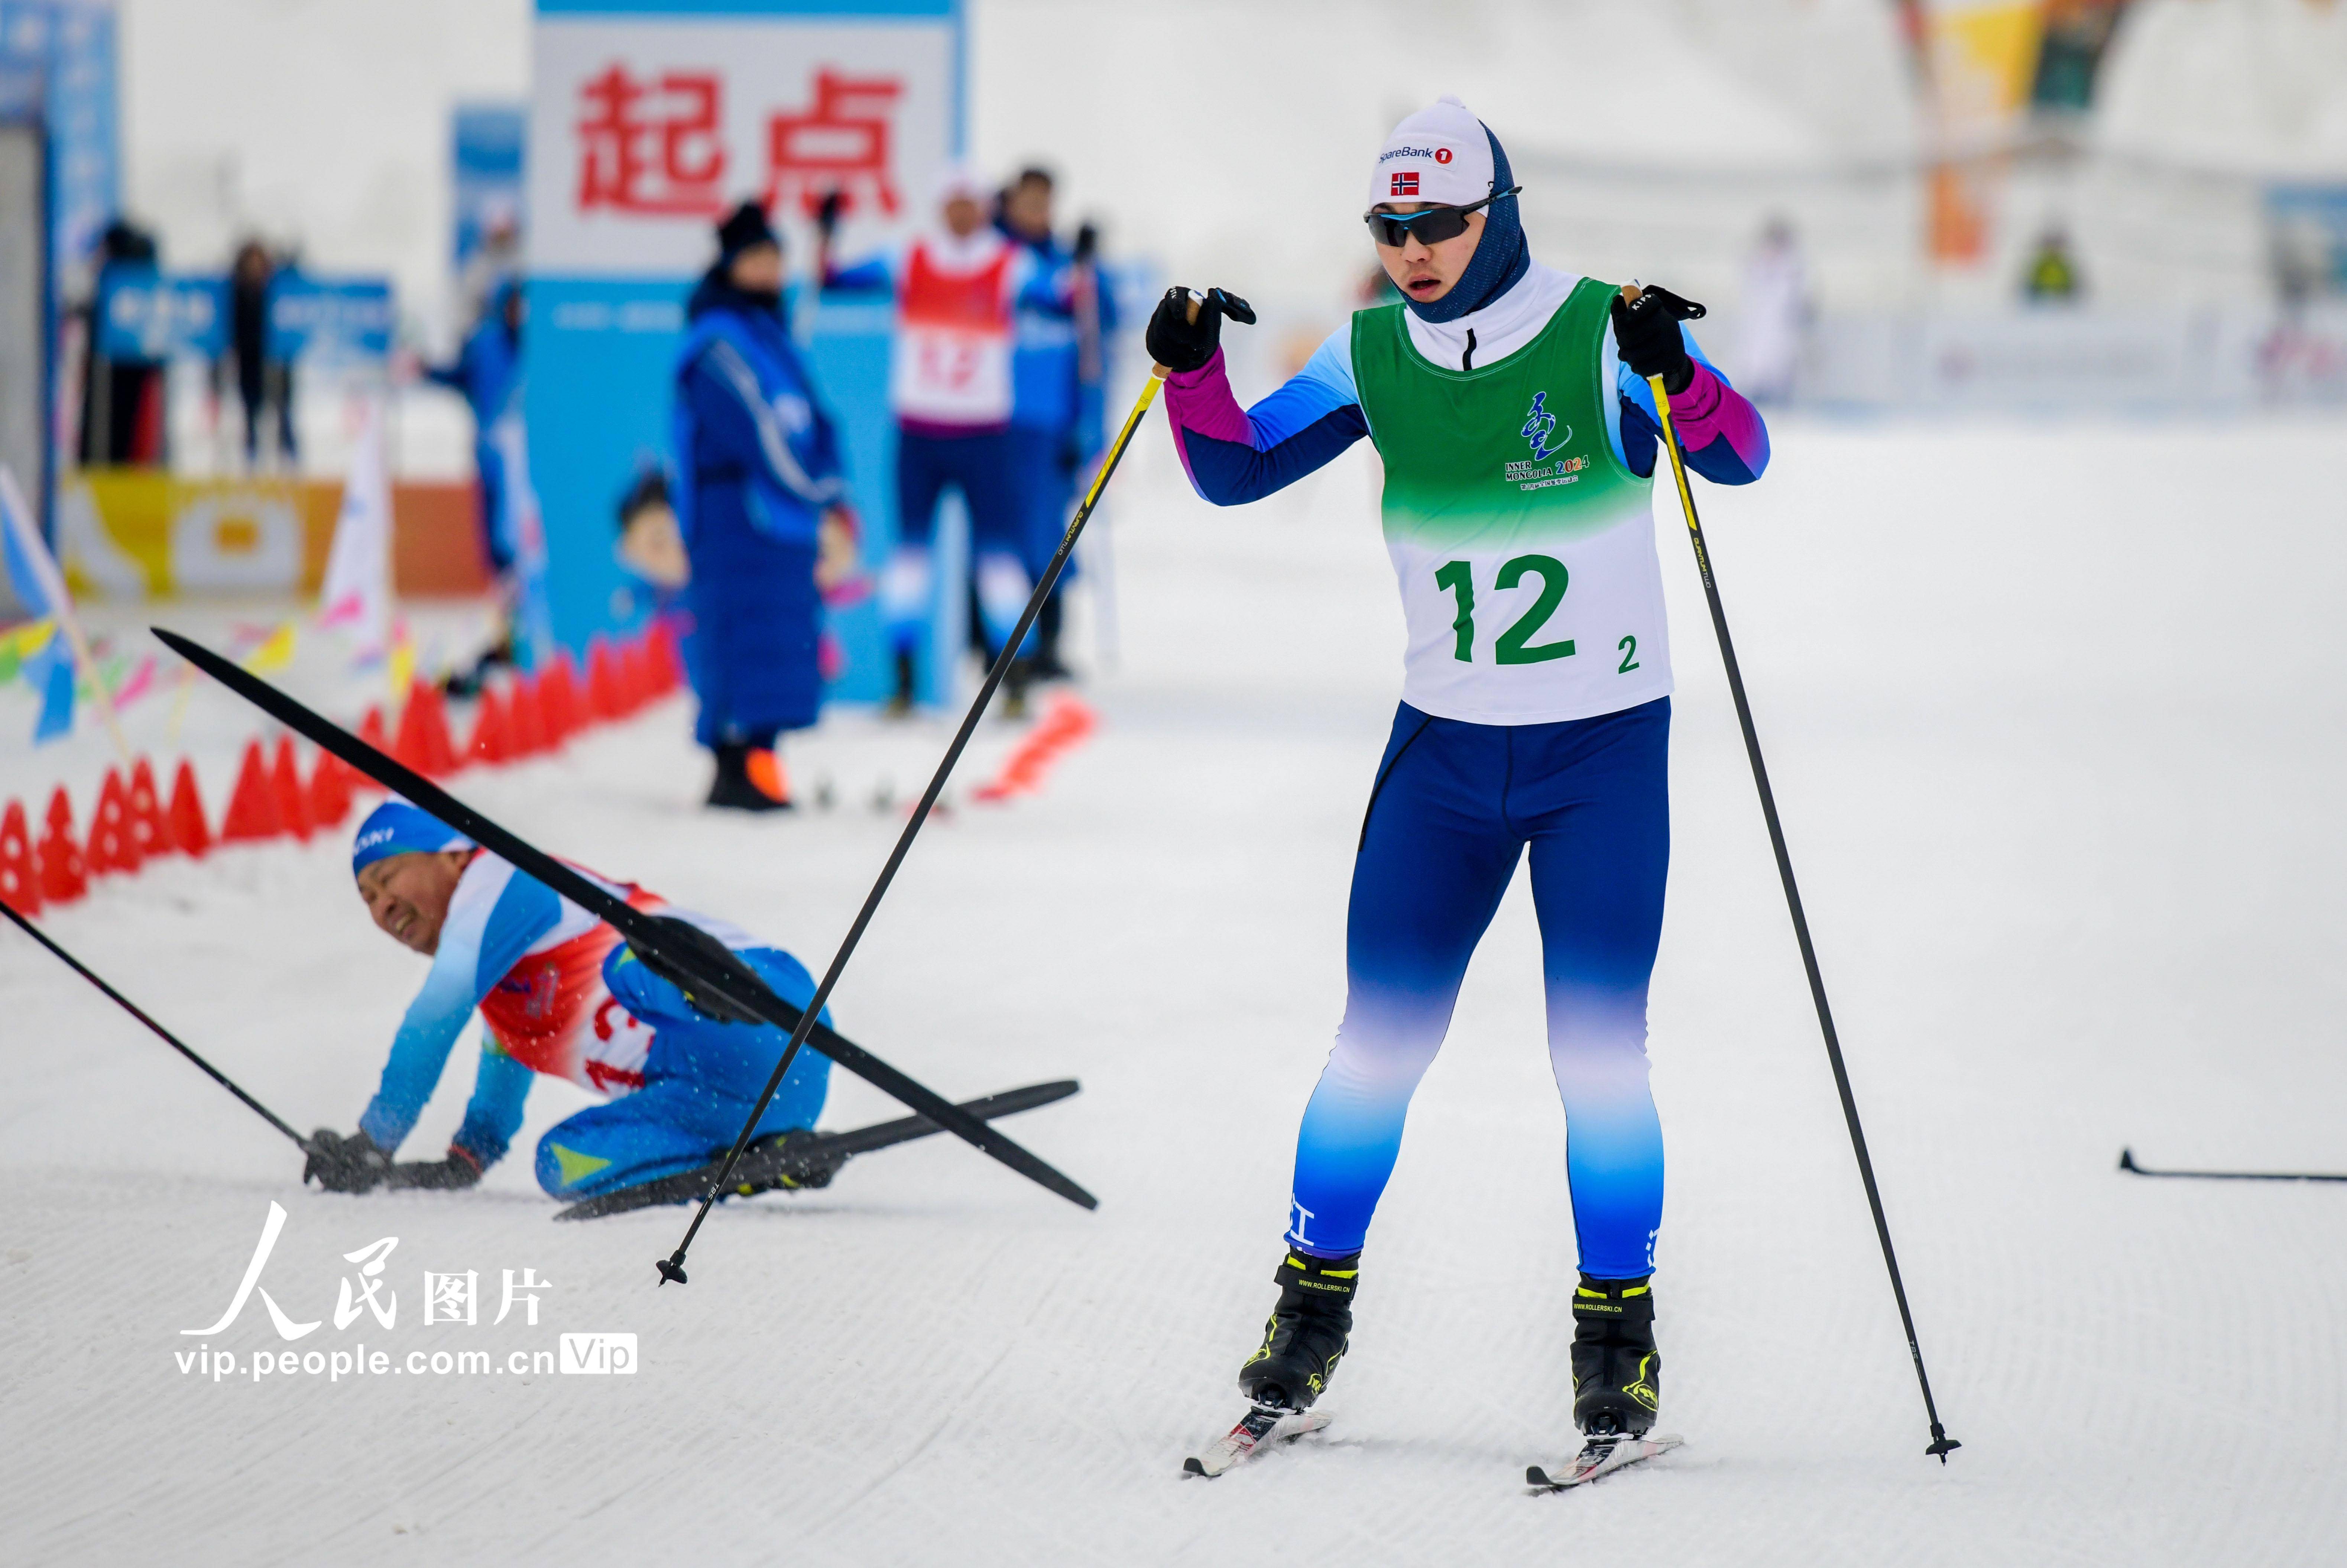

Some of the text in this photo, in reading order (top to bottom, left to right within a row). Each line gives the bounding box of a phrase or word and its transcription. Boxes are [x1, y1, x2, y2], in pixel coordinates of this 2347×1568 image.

[580, 63, 902, 224] 起点
[1378, 147, 1433, 163] SpareBank
[1505, 461, 1532, 472] INNER
[1506, 454, 1590, 482] MONGOLIA 2024
[1693, 537, 1707, 572] QUANTUM
[1435, 554, 1576, 665] 12
[1618, 635, 1640, 674] 2
[708, 1183, 720, 1200] TBS
[1299, 1279, 1350, 1293] WWW.ROLLERSKI.CN
[1573, 1303, 1623, 1313] WWW.ROLLERSKI.CN
